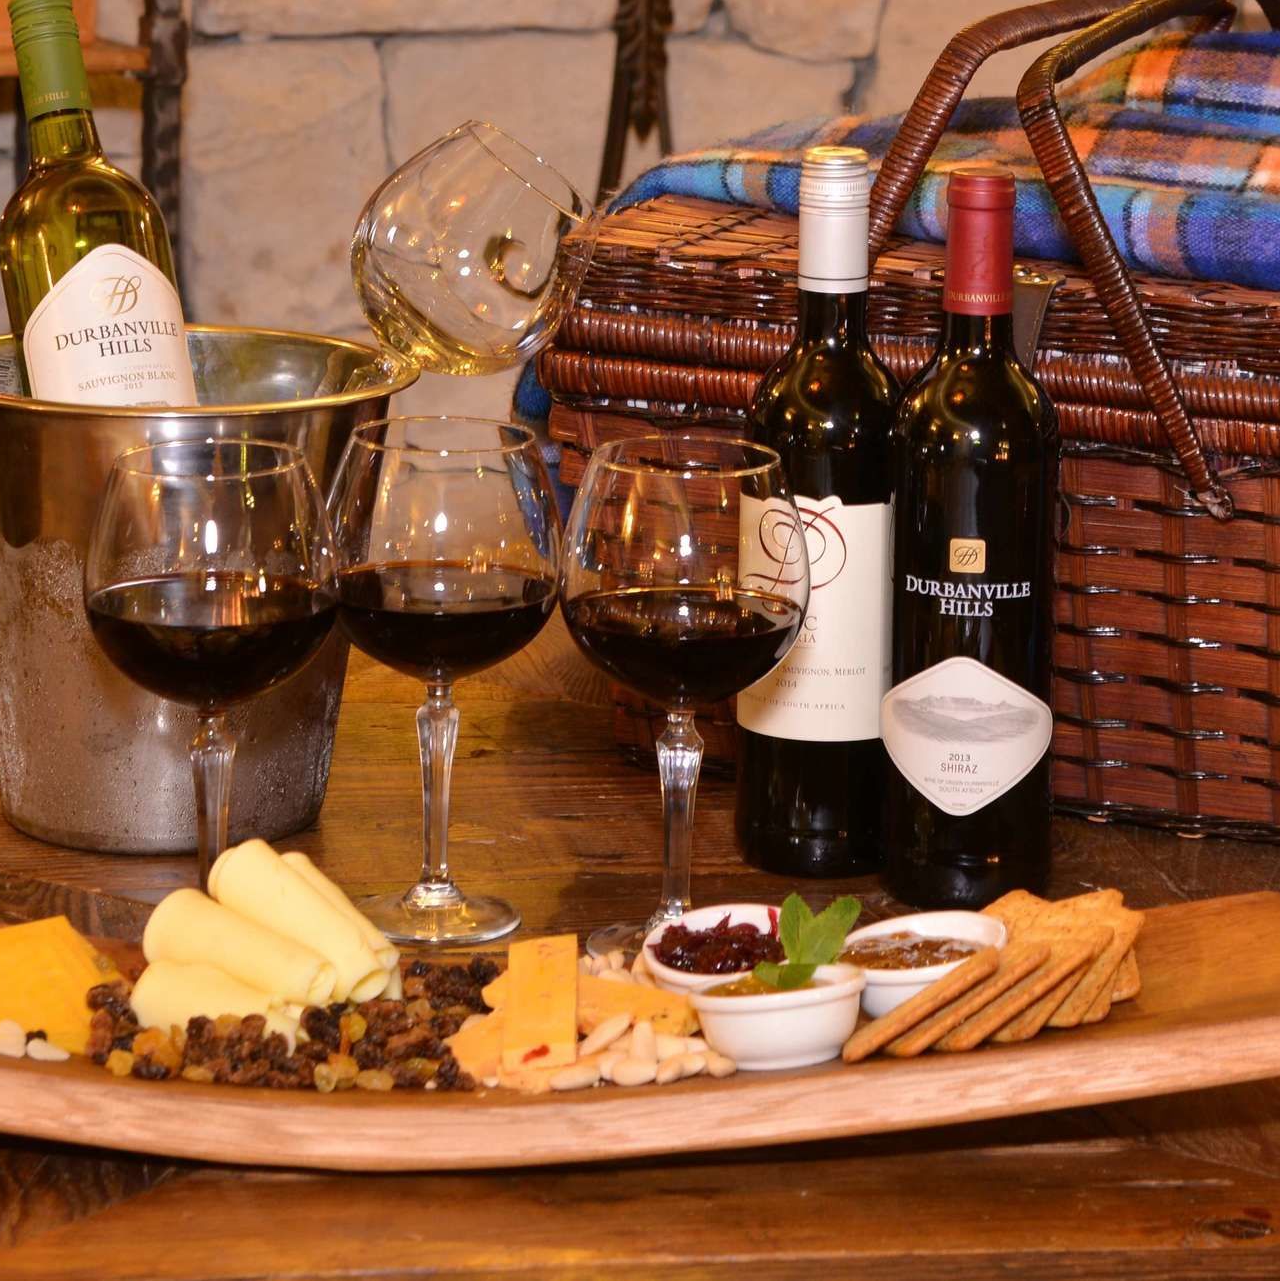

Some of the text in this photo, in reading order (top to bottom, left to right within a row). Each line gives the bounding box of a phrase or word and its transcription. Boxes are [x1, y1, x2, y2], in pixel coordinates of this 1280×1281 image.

[55, 320, 179, 351] DURBANVILLE
[99, 339, 152, 357] HILLS
[78, 370, 177, 391] SAUVIGNON BLANC
[906, 574, 1031, 599] DURBANVILLE
[939, 599, 994, 617] HILLS
[834, 666, 867, 676] MERLOT
[814, 703, 846, 711] AFRICA
[948, 753, 971, 762] 2013
[940, 763, 978, 774] SHIRAZ
